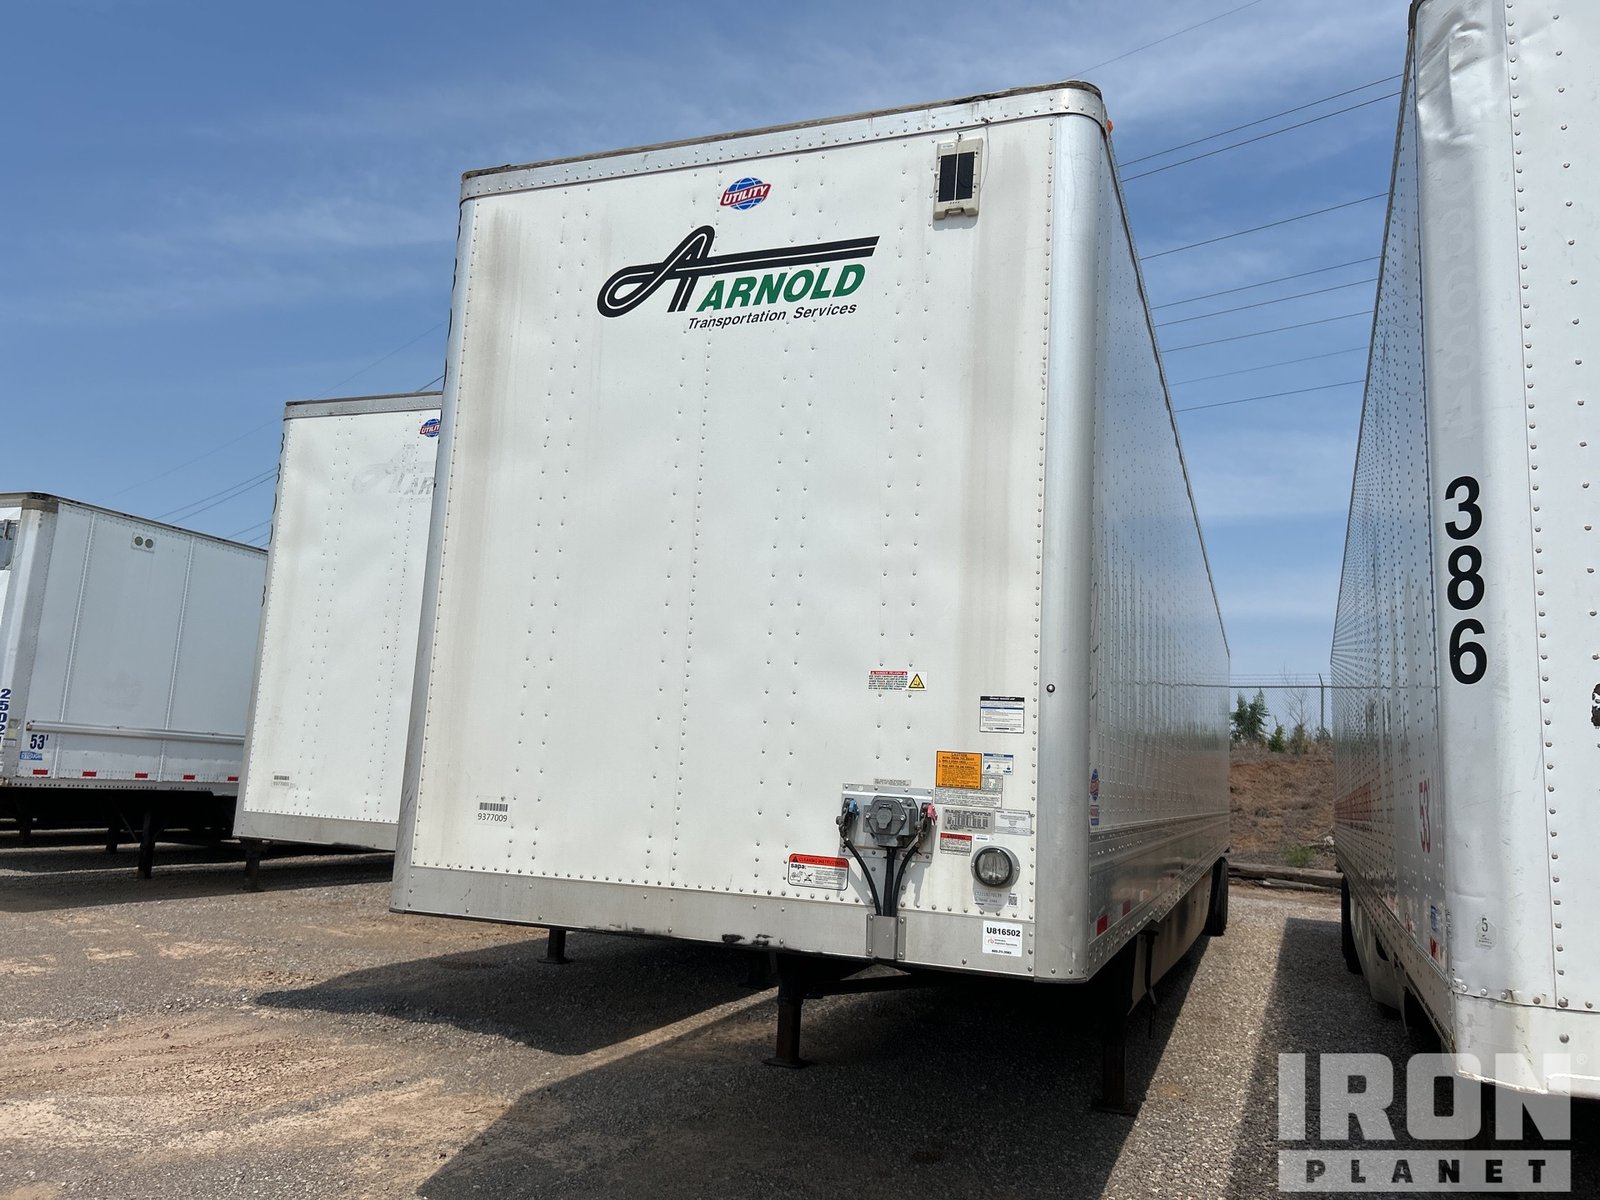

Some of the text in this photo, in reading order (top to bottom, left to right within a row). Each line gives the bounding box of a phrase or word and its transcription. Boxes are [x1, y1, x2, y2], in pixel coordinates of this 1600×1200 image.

[723, 185, 769, 205] UTILITY
[696, 263, 866, 312] ARNOLD
[688, 302, 857, 330] Transportation Services
[1444, 475, 1489, 685] 386
[477, 812, 508, 822] 9377009
[986, 926, 1021, 937] U816502
